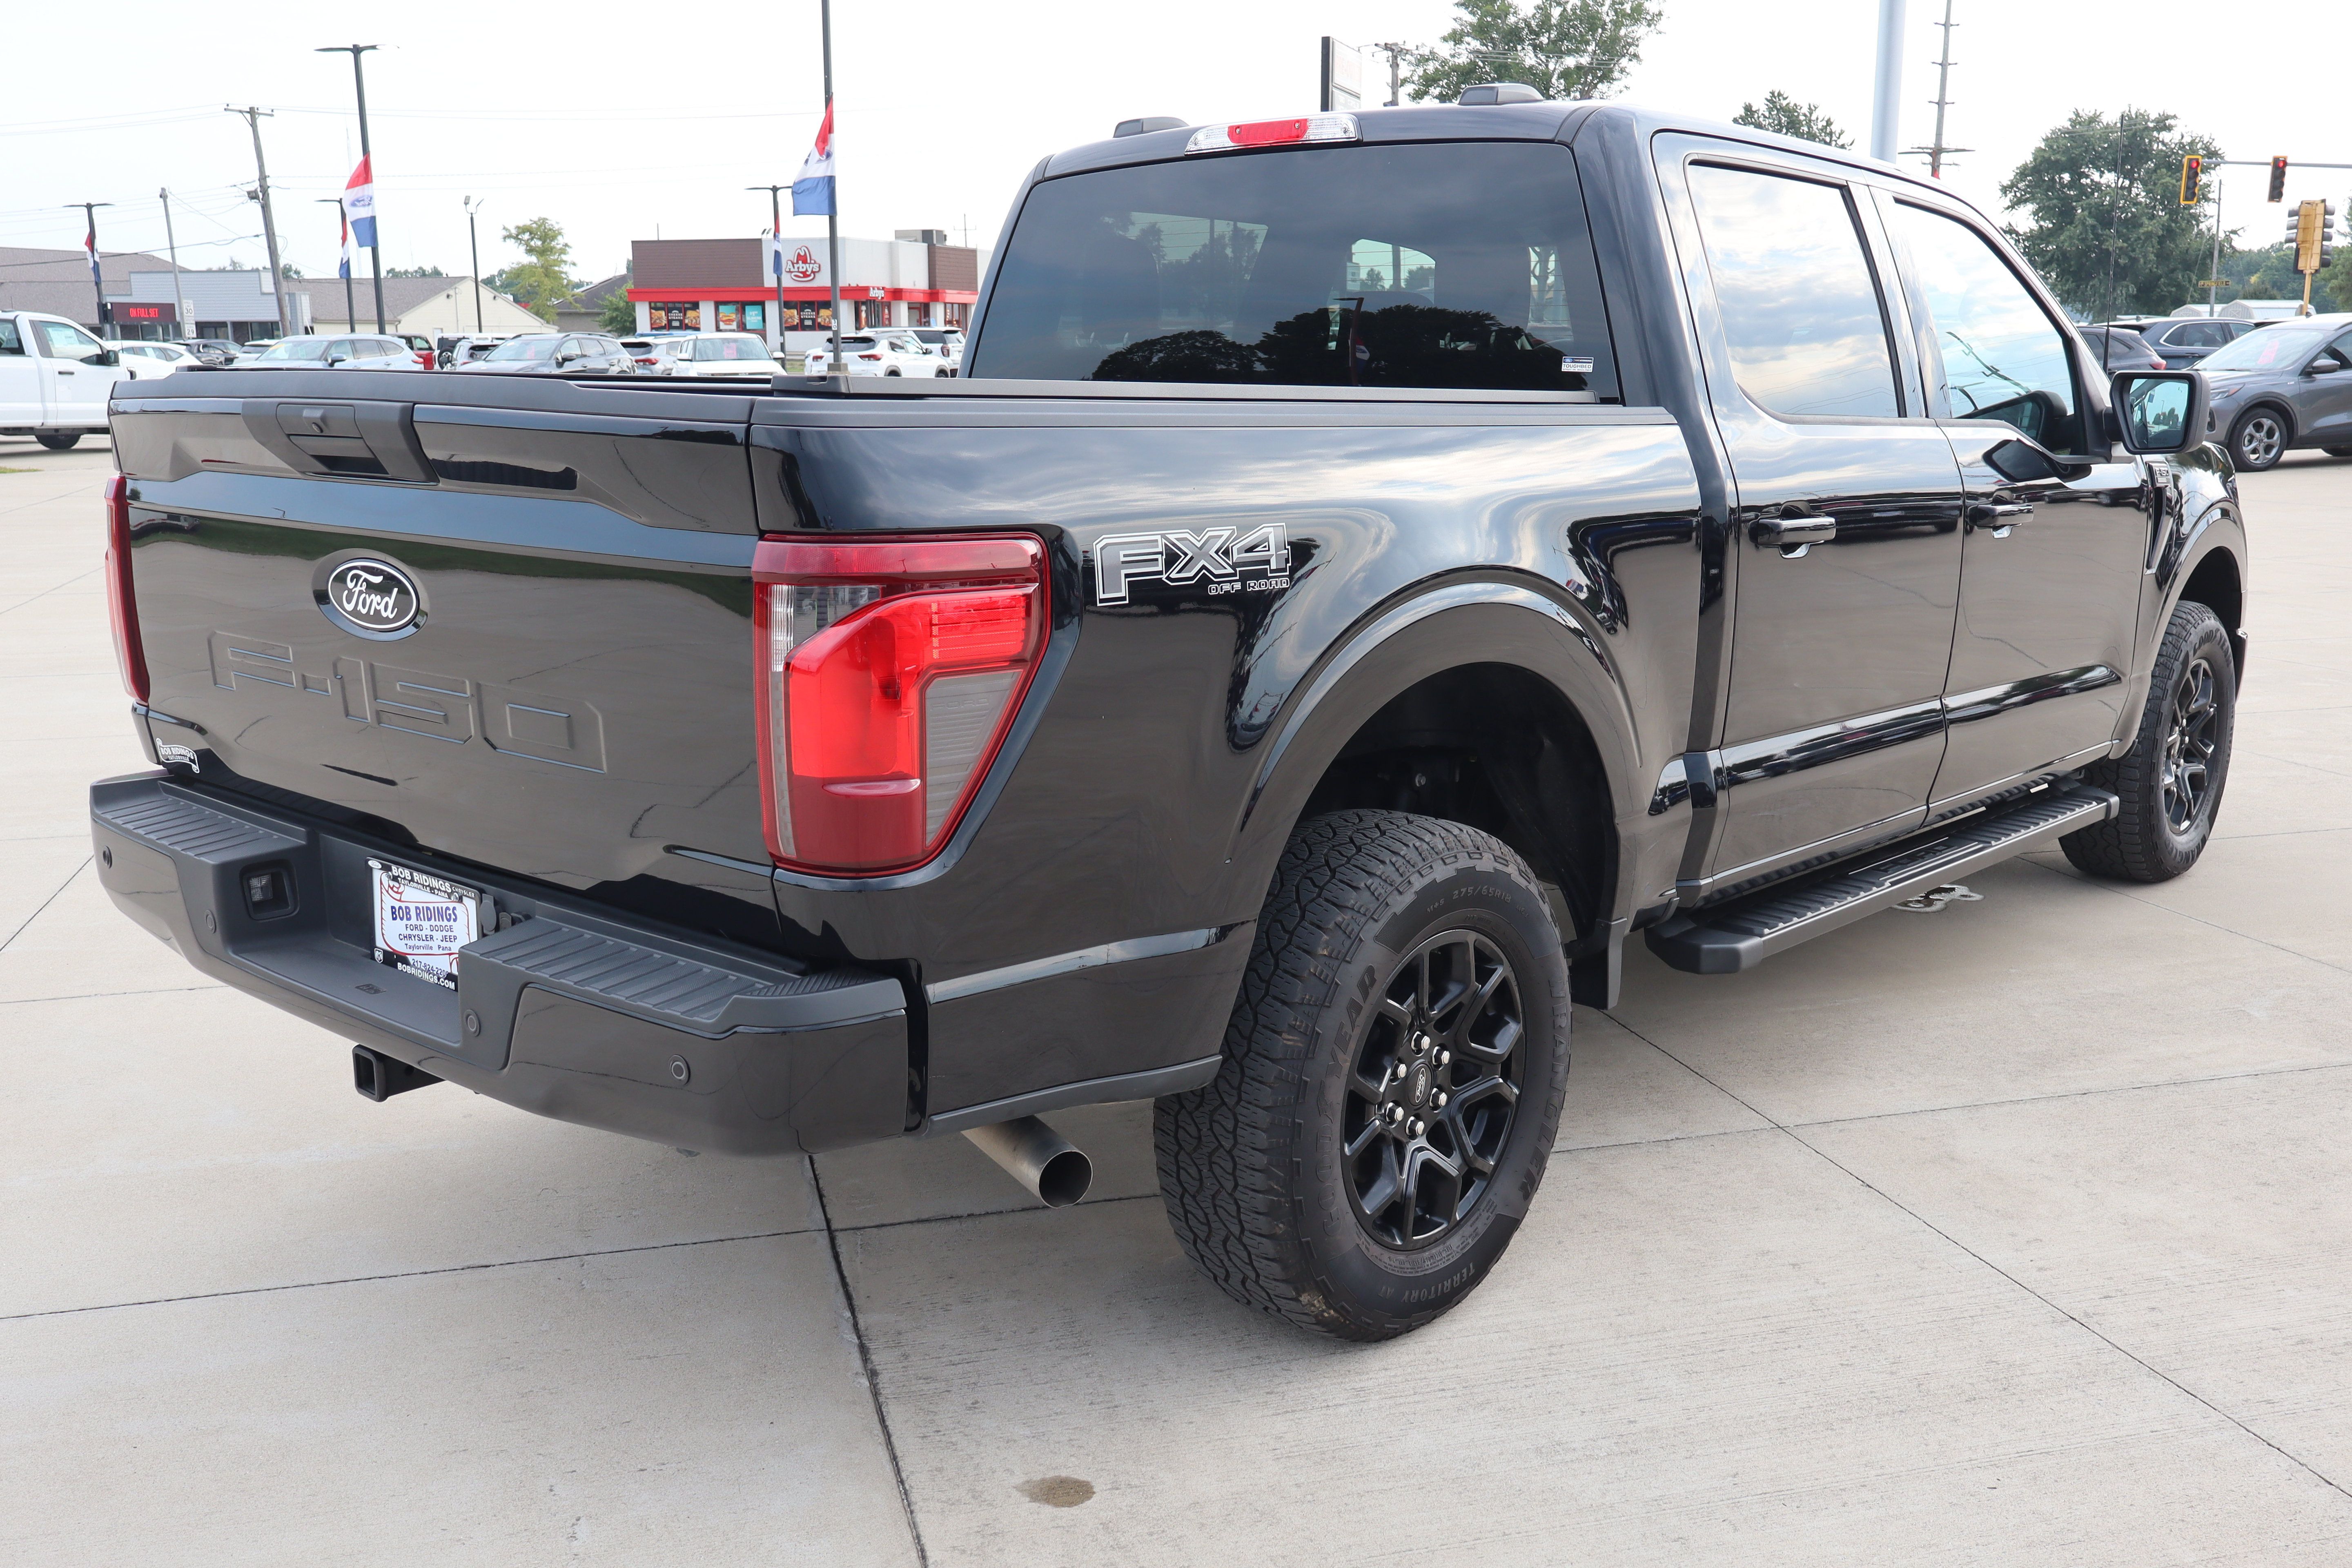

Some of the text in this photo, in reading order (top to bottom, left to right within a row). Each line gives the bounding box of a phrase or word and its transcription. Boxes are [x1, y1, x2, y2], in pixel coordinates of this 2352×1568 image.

[785, 260, 819, 275] Arby's
[869, 287, 884, 300] Arby's
[129, 308, 158, 317] ON FULL SET
[1093, 523, 1292, 606] FX4
[343, 570, 398, 619] Ford
[1208, 577, 1290, 595] OFF ROAD
[208, 631, 606, 774] F-150
[930, 698, 989, 711] FORD
[171, 747, 194, 760] RIDINGS
[391, 866, 412, 880] BOB
[413, 871, 452, 893] RIDINGS
[397, 878, 431, 893] TAYLORVILLE
[435, 889, 449, 898] PANA
[1452, 885, 1512, 904] 275/65R18
[390, 905, 458, 922] BOB RIDINGS
[399, 933, 434, 942] CHRYSLER
[397, 962, 455, 990] BOBRIDINGS.COM
[1315, 963, 1376, 1236] GOODYEAR
[1401, 1262, 1475, 1303] TERRITORY
[1377, 1285, 1395, 1300] AT
